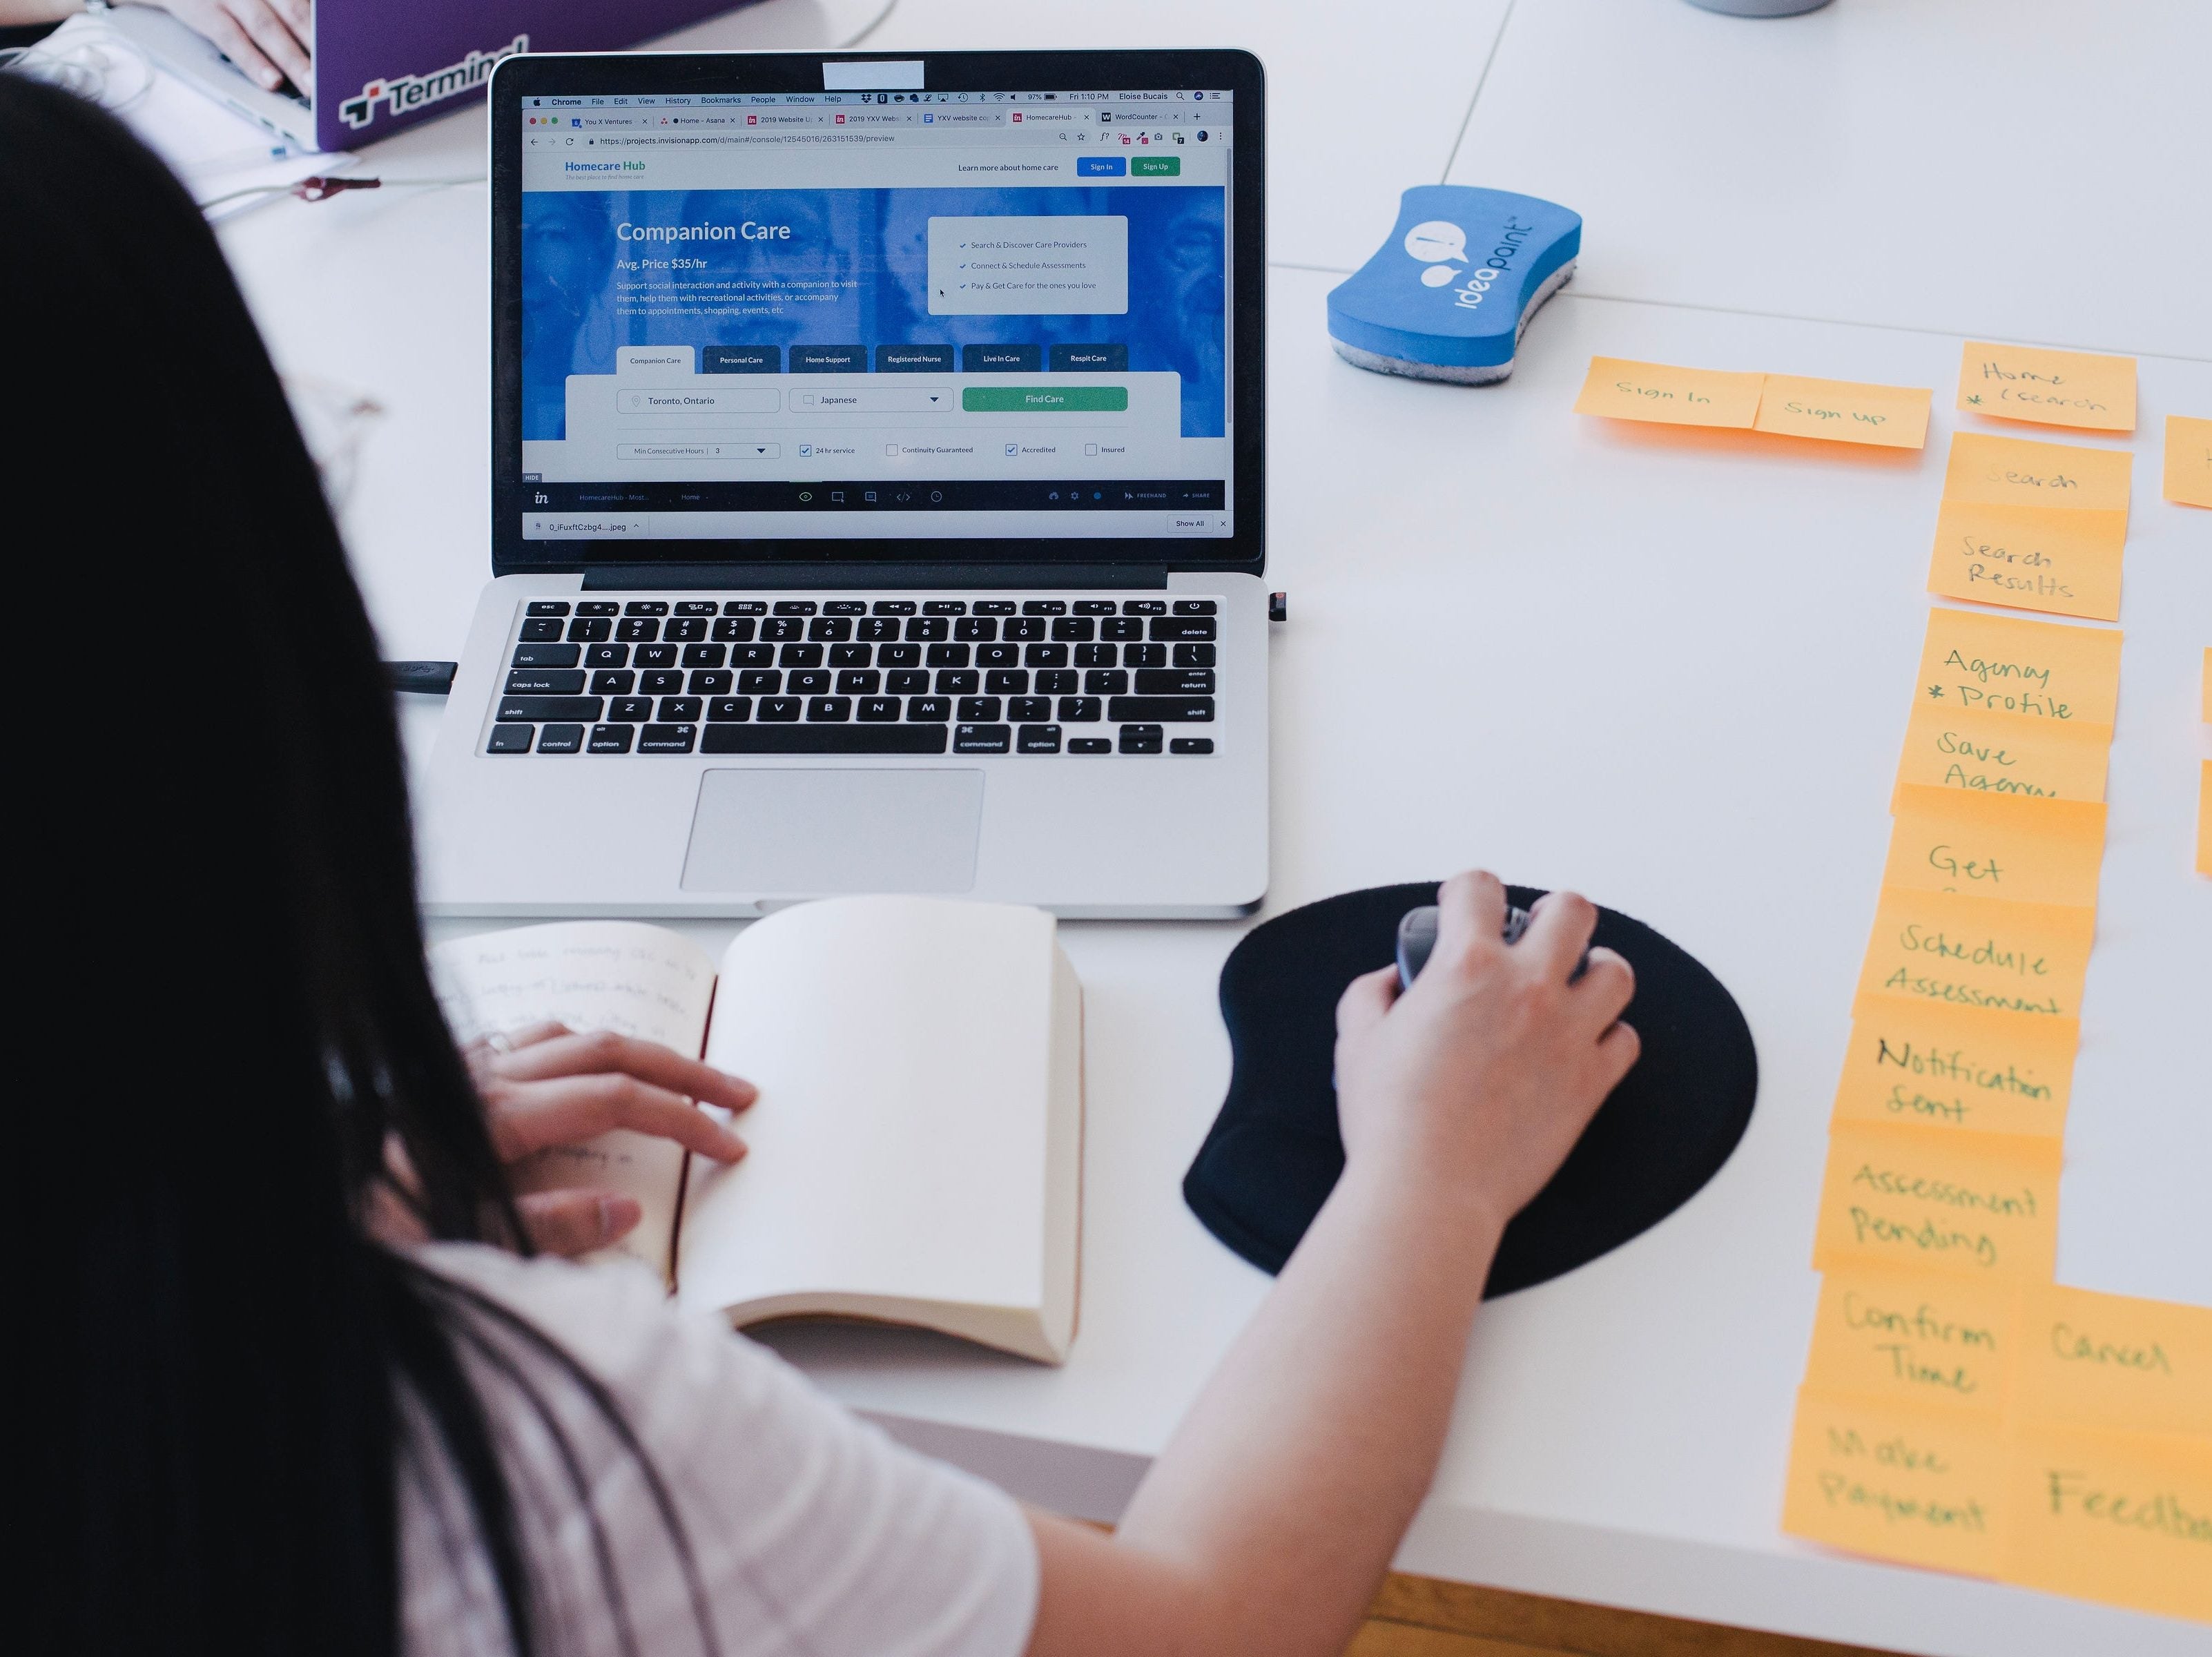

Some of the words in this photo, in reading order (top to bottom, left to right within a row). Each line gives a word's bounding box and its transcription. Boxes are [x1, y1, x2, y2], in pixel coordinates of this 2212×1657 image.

[388, 40, 523, 109] Termin
[666, 97, 691, 106] History
[750, 96, 776, 104] People
[824, 96, 842, 104] Help
[565, 161, 621, 171] Homecare
[623, 161, 646, 171] Hub
[1156, 163, 1169, 171] Up
[616, 222, 737, 245] Companion
[741, 222, 791, 240] Care
[1052, 240, 1087, 249] Providers
[617, 259, 639, 272] Avg.
[642, 259, 669, 269] Price
[671, 258, 708, 270] $35/hr
[1001, 261, 1007, 269] &
[1008, 261, 1040, 269] Schedule
[1041, 261, 1086, 269] Assessments
[617, 281, 647, 291] Support
[649, 281, 670, 289] social
[672, 281, 715, 289] interaction
[716, 281, 730, 289] and
[731, 281, 761, 291] activity
[761, 280, 779, 289] with
[787, 280, 830, 291] companion
[831, 280, 840, 289] to
[840, 280, 857, 289] visit
[971, 282, 984, 291] Pay
[1067, 283, 1080, 291] you
[1080, 281, 1096, 289] love
[617, 294, 638, 304] them,
[639, 294, 657, 304] help
[658, 293, 678, 302] them
[679, 293, 697, 302] with
[698, 293, 745, 302] recreational
[746, 293, 783, 303] activities,
[795, 295, 839, 303] accompany
[617, 307, 636, 315] them
[638, 307, 646, 315] to
[648, 307, 703, 316] appointments,
[704, 306, 741, 316] shopping,
[742, 306, 770, 316] events,
[771, 306, 784, 314] etc
[630, 357, 665, 366] Companion
[825, 356, 851, 365] Support
[887, 356, 920, 365] Registered
[1070, 355, 1091, 363] Respit
[1983, 362, 2066, 385] Home
[1025, 395, 1044, 403] Find
[1045, 395, 1064, 403] Care
[1616, 382, 1673, 400] Sign
[1689, 392, 1711, 405] In
[648, 397, 682, 407] Toronto,
[683, 396, 715, 405] Ontario
[820, 396, 857, 406] Japanese
[1784, 402, 1841, 420] Sign
[1853, 414, 1886, 426] up
[902, 447, 935, 455] Continuity
[1985, 461, 2078, 489] Search
[1963, 536, 2052, 568] Search
[1968, 563, 2075, 598] Results
[1943, 650, 2050, 690] Agency
[1958, 685, 2073, 719] Profile
[1937, 732, 2017, 766] Save
[1929, 845, 2003, 882] Get
[1900, 924, 2047, 976] Schedule
[1877, 1038, 2052, 1101] Notification
[1852, 1163, 2037, 1217] Assessment
[1849, 1205, 1998, 1268] Pending
[1844, 1291, 1997, 1350] Confirm
[2050, 1321, 2173, 1377] Cancel
[1874, 1344, 1978, 1393] Time
